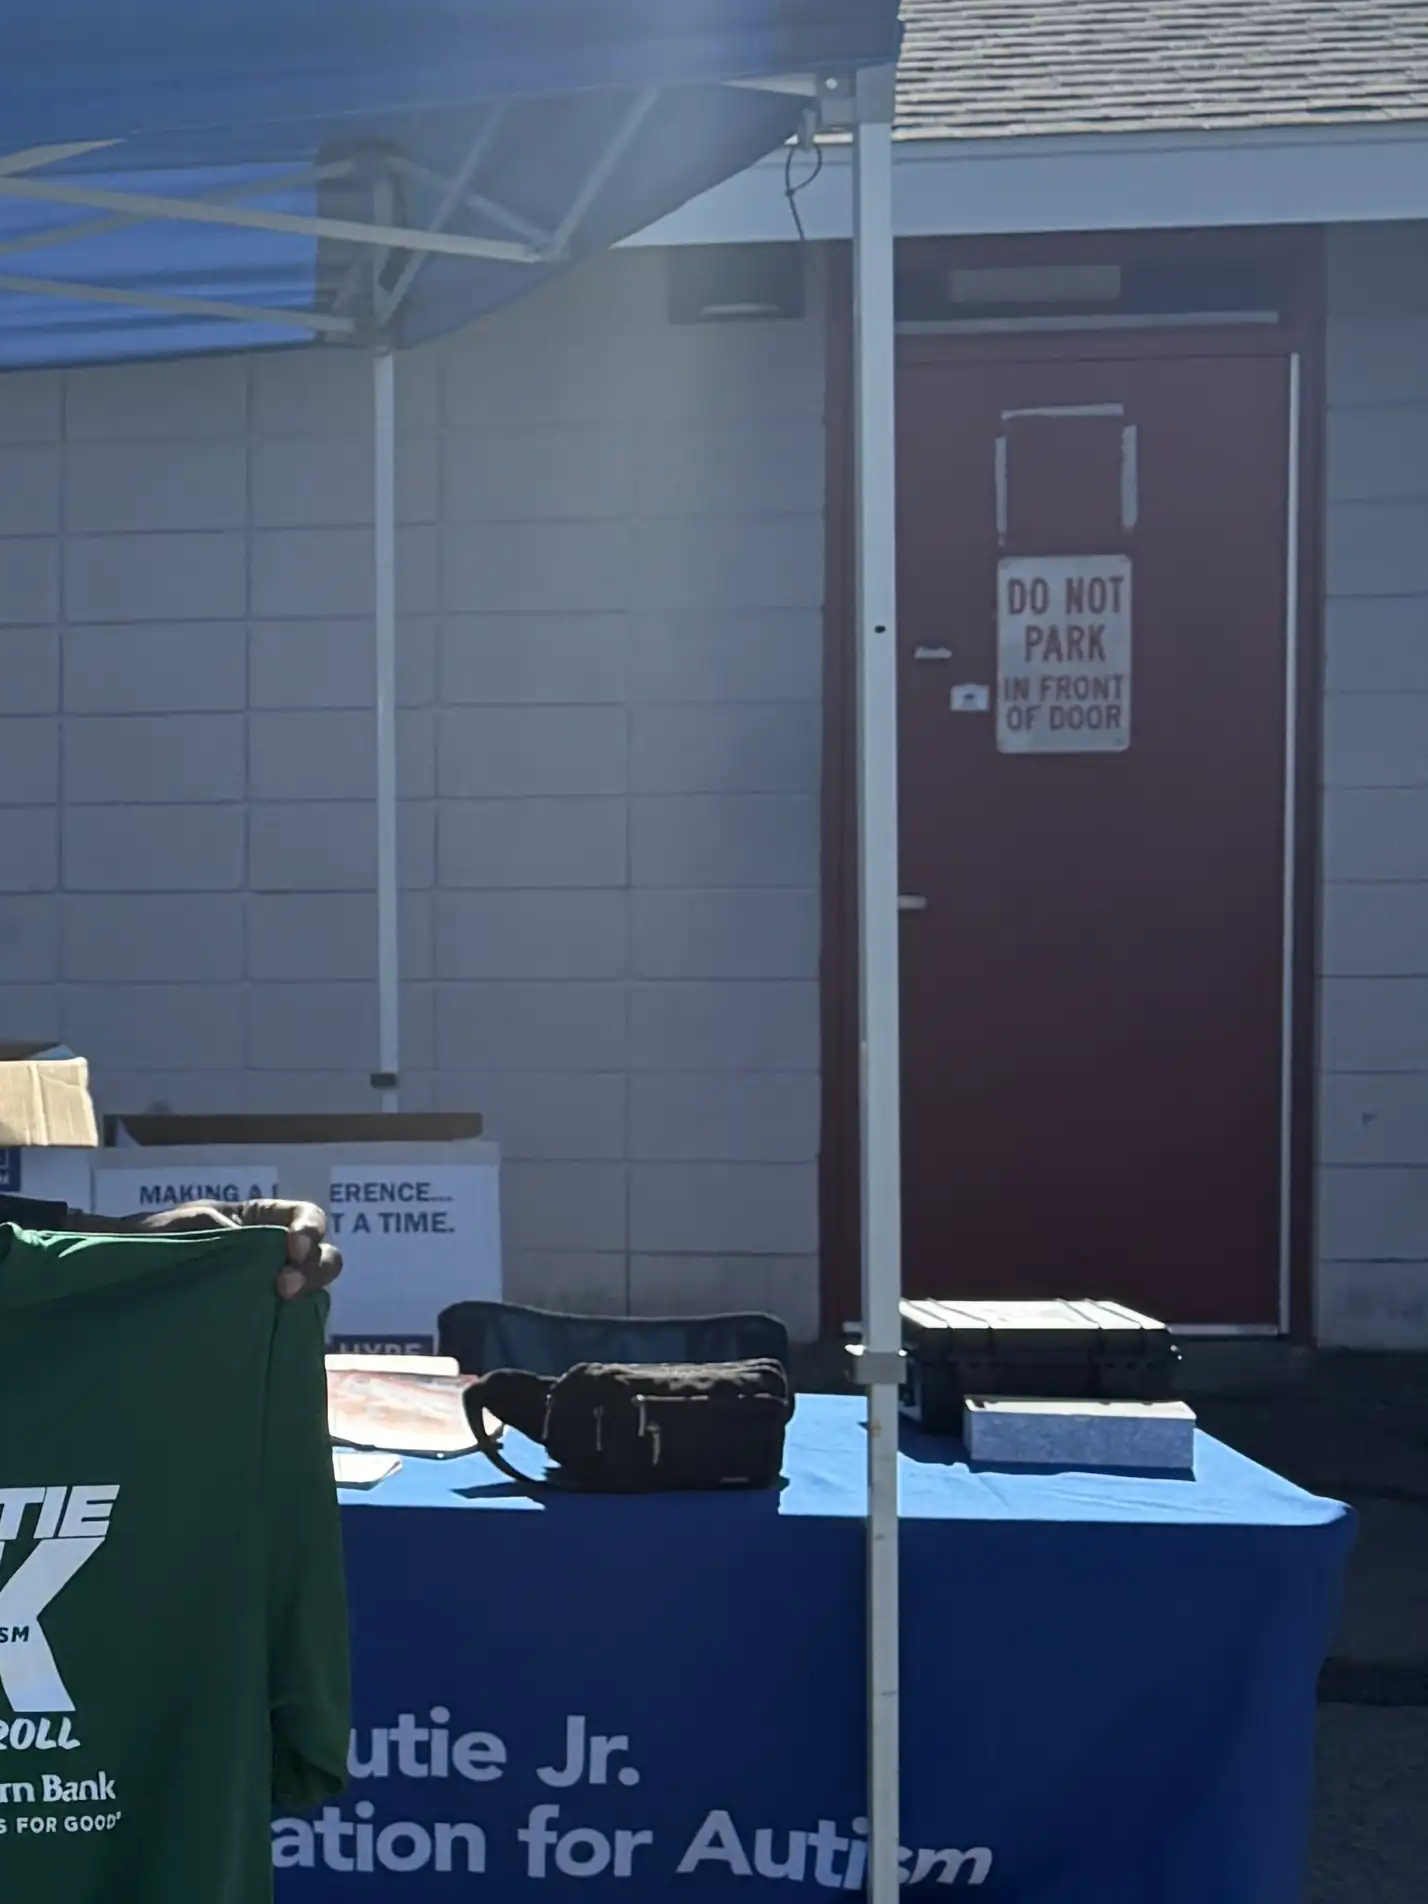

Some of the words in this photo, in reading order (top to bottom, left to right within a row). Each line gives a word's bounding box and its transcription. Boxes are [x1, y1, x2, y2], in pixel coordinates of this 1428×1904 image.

[1006, 576, 1050, 616] DO
[1064, 575, 1125, 615] NOT
[1023, 623, 1107, 664] PARK
[1003, 676, 1030, 703] IN
[1039, 673, 1125, 702] FRONT
[1005, 704, 1041, 732] OF
[1048, 703, 1123, 732] DOOR
[139, 1183, 240, 1205] MAKING
[350, 1211, 372, 1234] A
[376, 1211, 456, 1234] TIME.
[346, 1706, 507, 1782] utie
[536, 1715, 641, 1788] Jr.
[41, 1770, 117, 1803] Bank
[16, 1816, 58, 1834] FOR
[270, 1800, 486, 1874] ation
[518, 1804, 653, 1879] for
